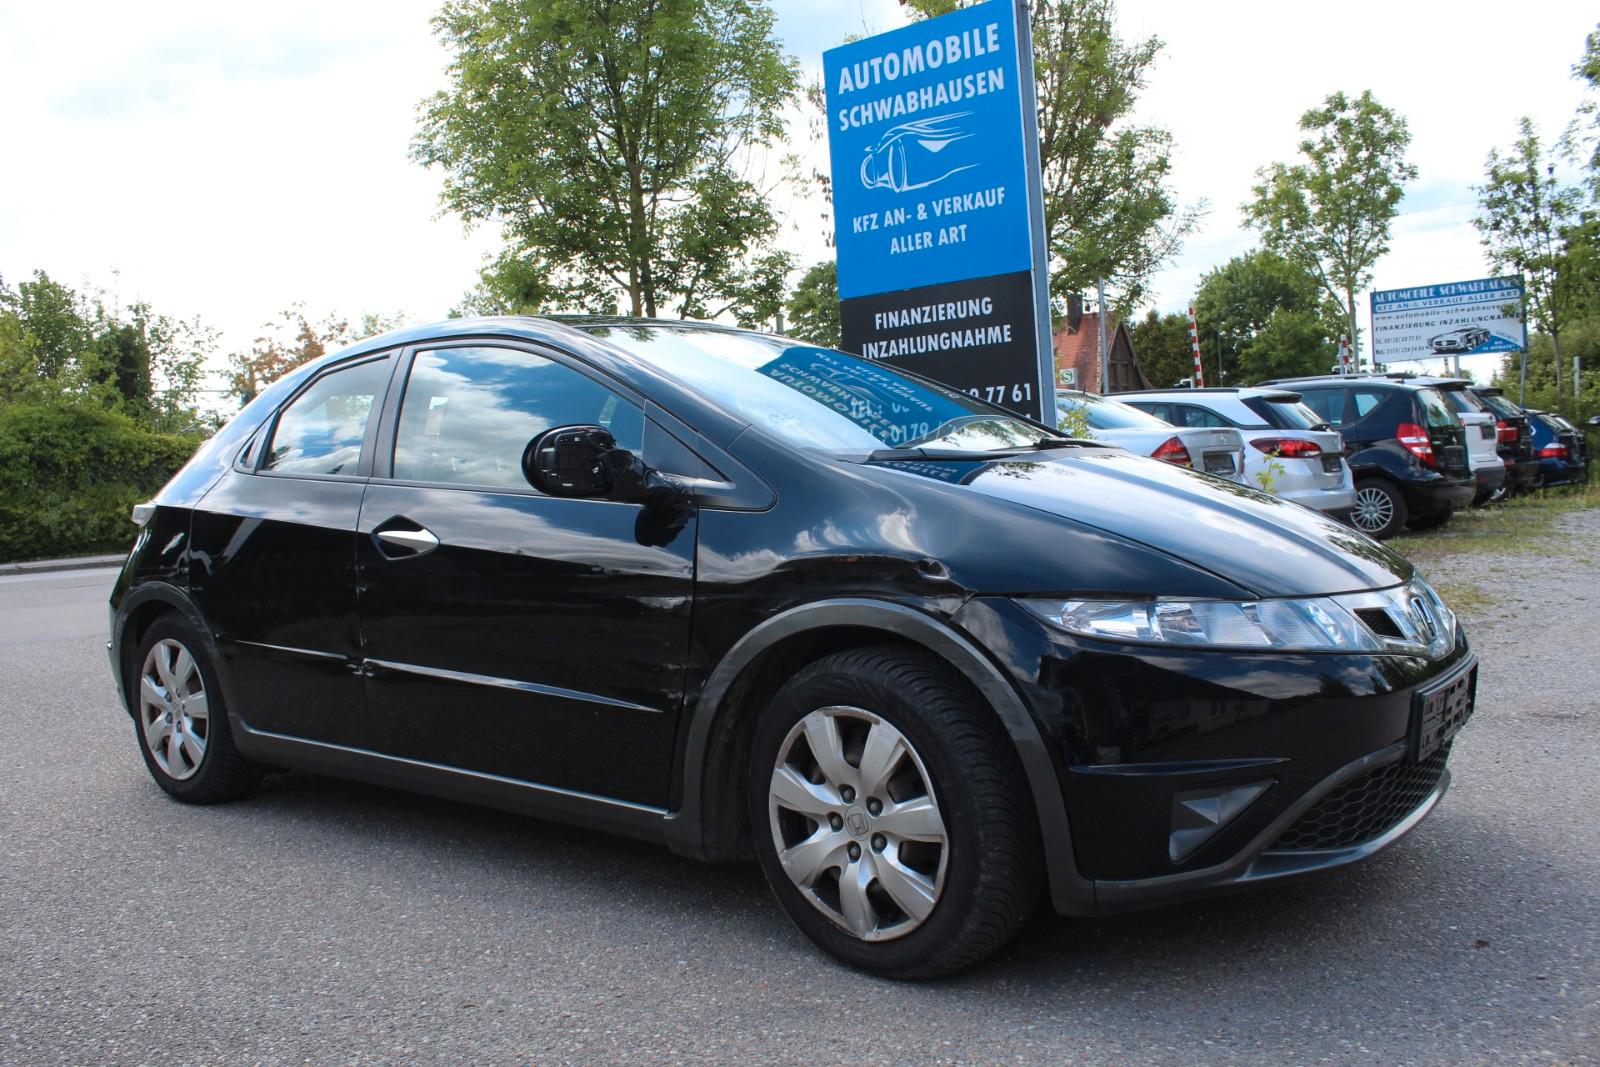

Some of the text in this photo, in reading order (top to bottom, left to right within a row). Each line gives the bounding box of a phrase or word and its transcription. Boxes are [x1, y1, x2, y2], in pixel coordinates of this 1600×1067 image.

[838, 22, 1000, 95] AUTOMOBILE
[838, 67, 1005, 131] SCHWABHAUSEN
[853, 187, 1006, 234] KFZ AN- & VERKAUF
[890, 224, 968, 255] ALLER ART
[1375, 286, 1437, 303] AUTOMOBILE
[1423, 297, 1463, 307] VERKAUF
[1468, 293, 1495, 301] ALLER
[1500, 290, 1519, 298] ART
[875, 296, 993, 330] FINANZIERUNG
[1375, 320, 1437, 332] FINANZIERUNG
[862, 324, 1012, 359] INZAHLUNGNAHME
[985, 385, 1006, 404] 77
[1012, 383, 1031, 403] 61
